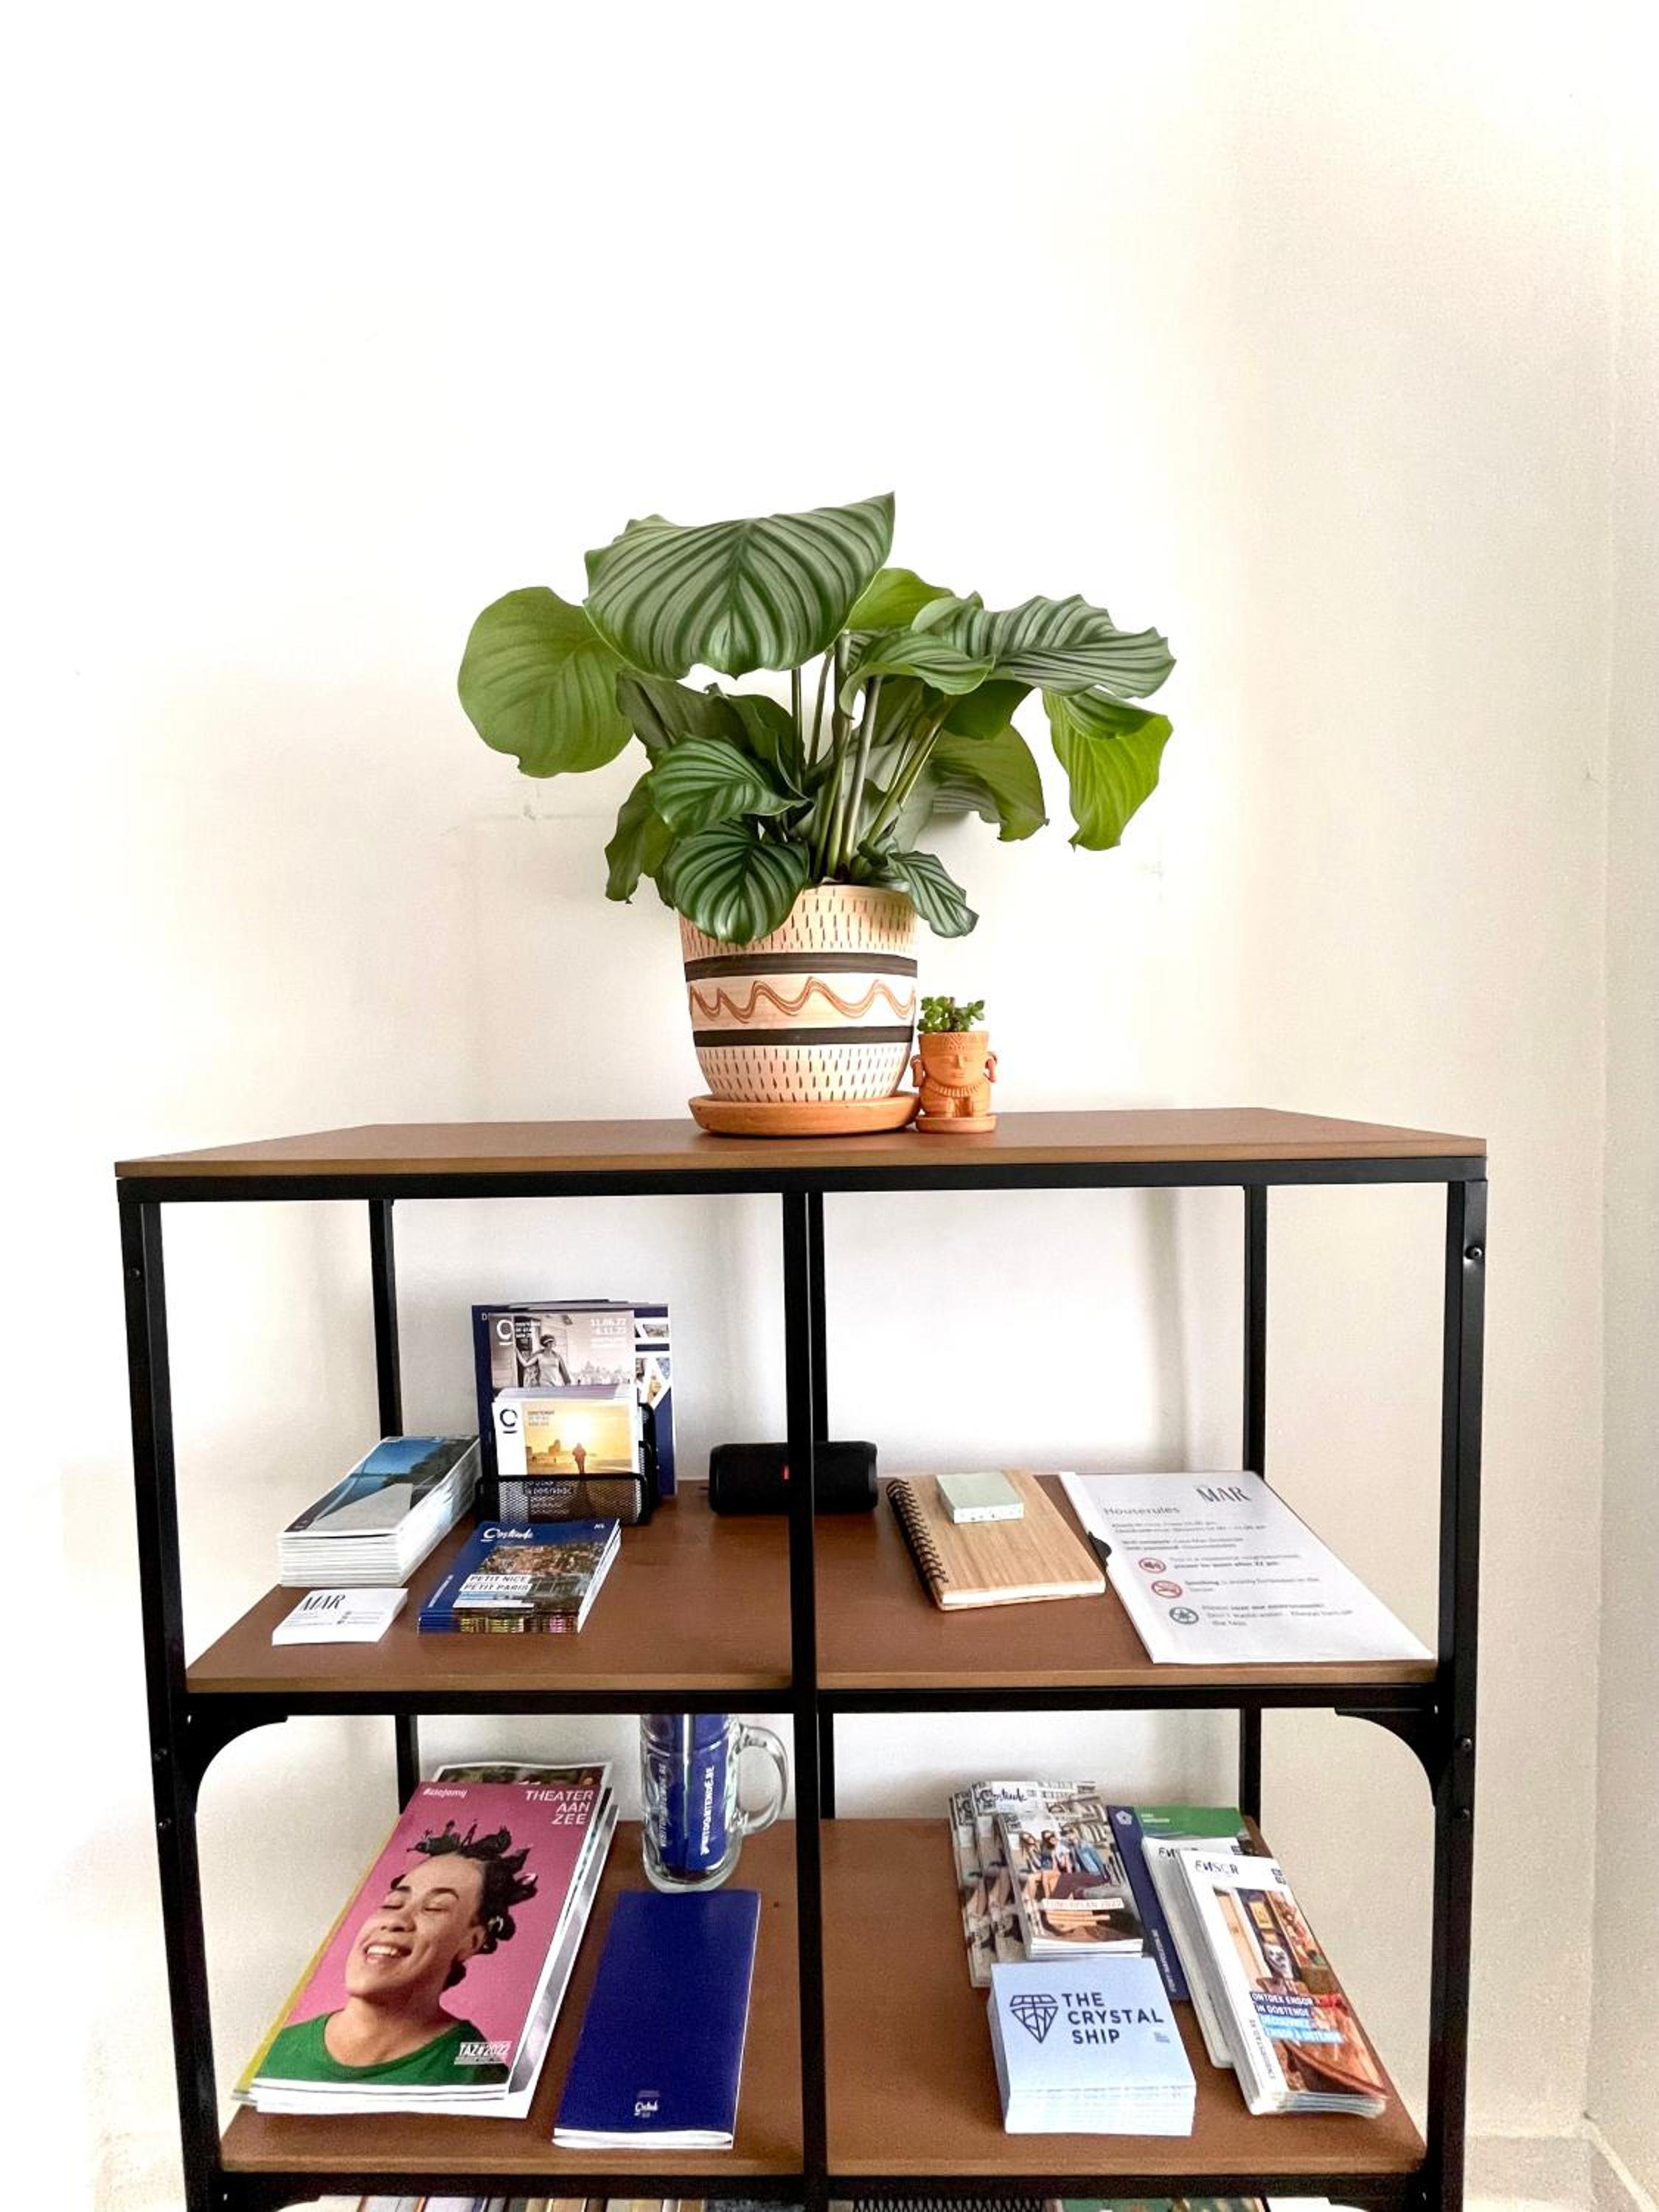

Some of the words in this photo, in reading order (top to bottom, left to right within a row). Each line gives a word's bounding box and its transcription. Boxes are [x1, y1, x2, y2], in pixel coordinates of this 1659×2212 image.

[1196, 1486, 1251, 1503] MAR
[524, 1790, 594, 1802] THEATER
[556, 1802, 591, 1814] AAN
[552, 1814, 587, 1826] ZEE
[1062, 1992, 1105, 2008] THE
[1068, 2008, 1165, 2025] CRYSTAL
[1071, 2029, 1121, 2045] SHIP
[459, 2041, 511, 2056] TAZ#2022
